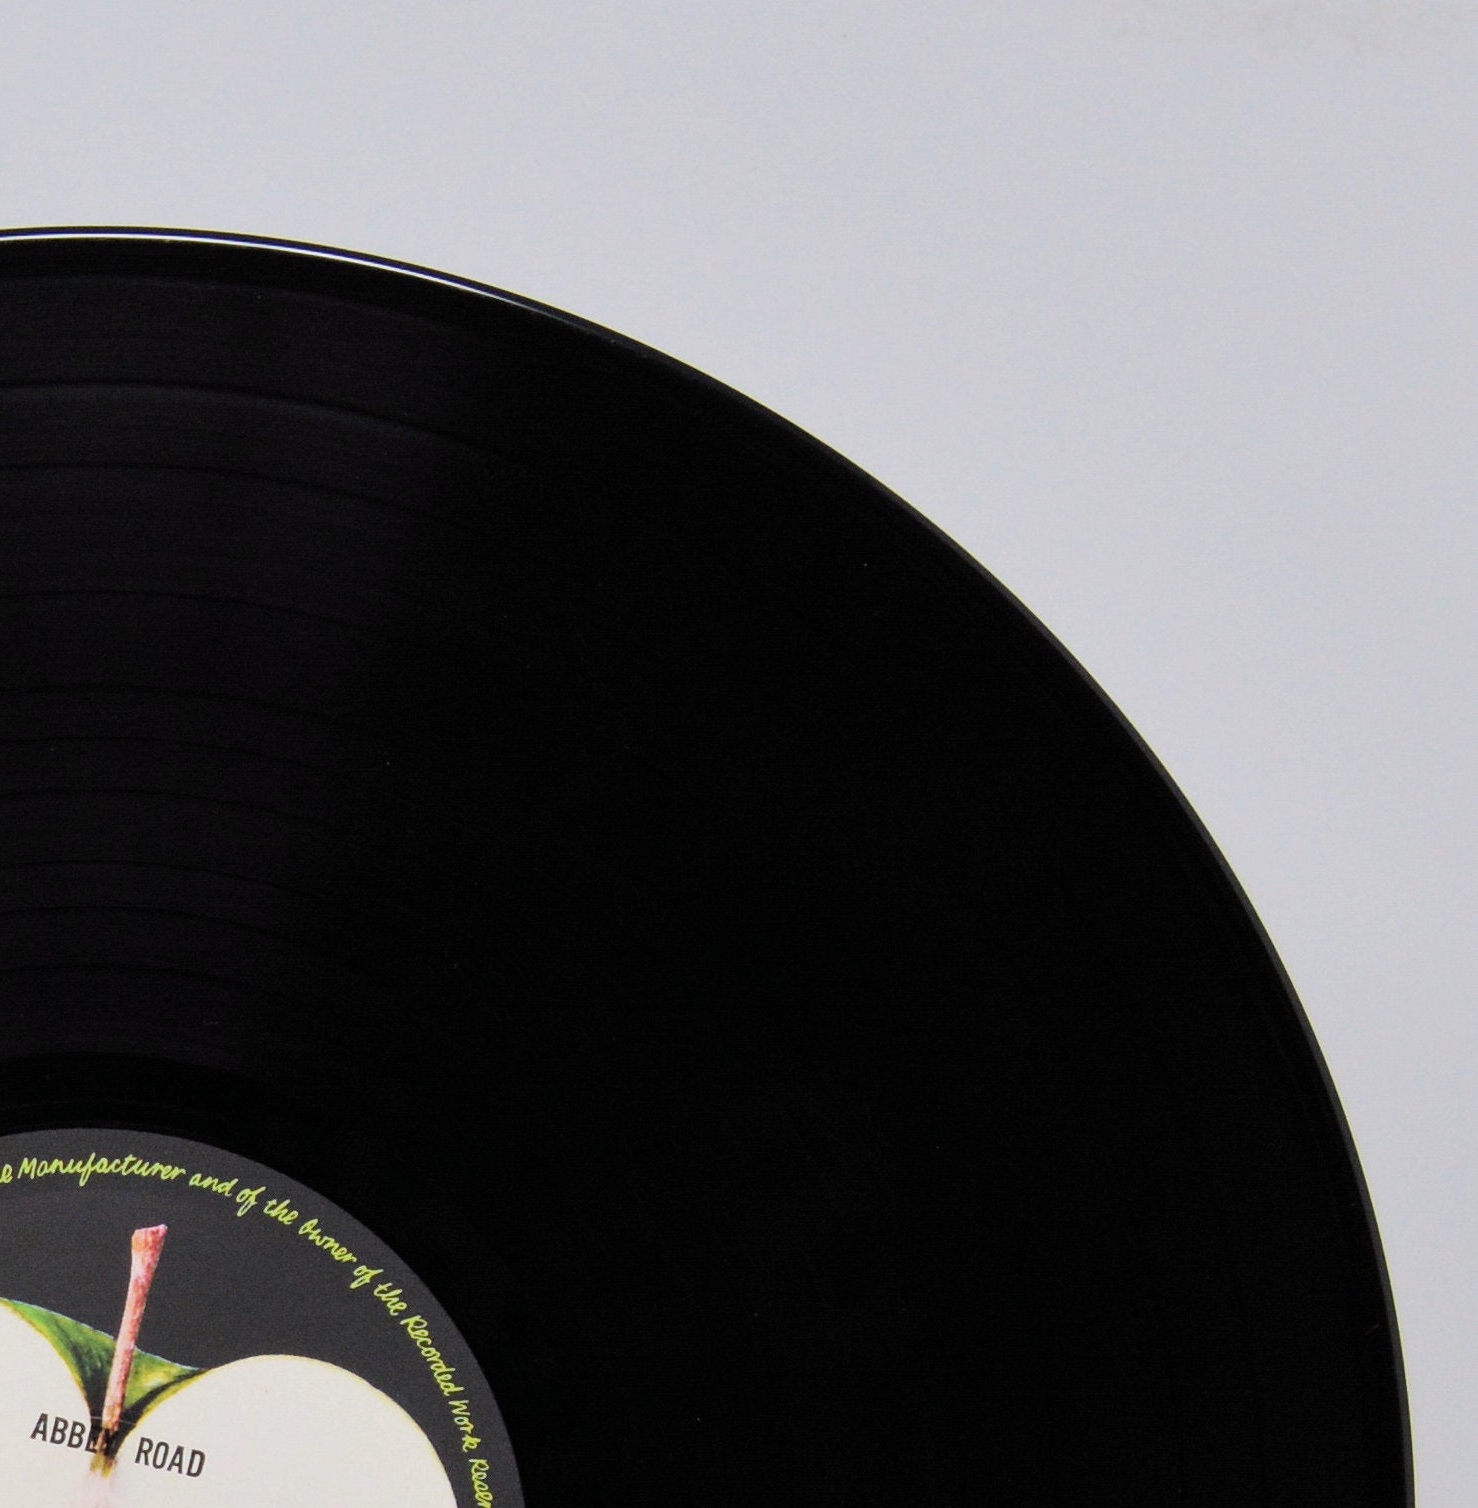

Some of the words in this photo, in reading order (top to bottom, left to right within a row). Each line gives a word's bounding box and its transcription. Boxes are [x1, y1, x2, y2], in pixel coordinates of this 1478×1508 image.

[18, 1152, 186, 1186] Manufacturer
[189, 1172, 236, 1197] and
[236, 1187, 265, 1217] of
[263, 1198, 300, 1226] the
[299, 1218, 357, 1264] Owner
[350, 1265, 384, 1290] of
[373, 1282, 407, 1317] the
[400, 1314, 465, 1397] Recorded
[448, 1399, 481, 1453] Work
[134, 1436, 206, 1478] ROAD
